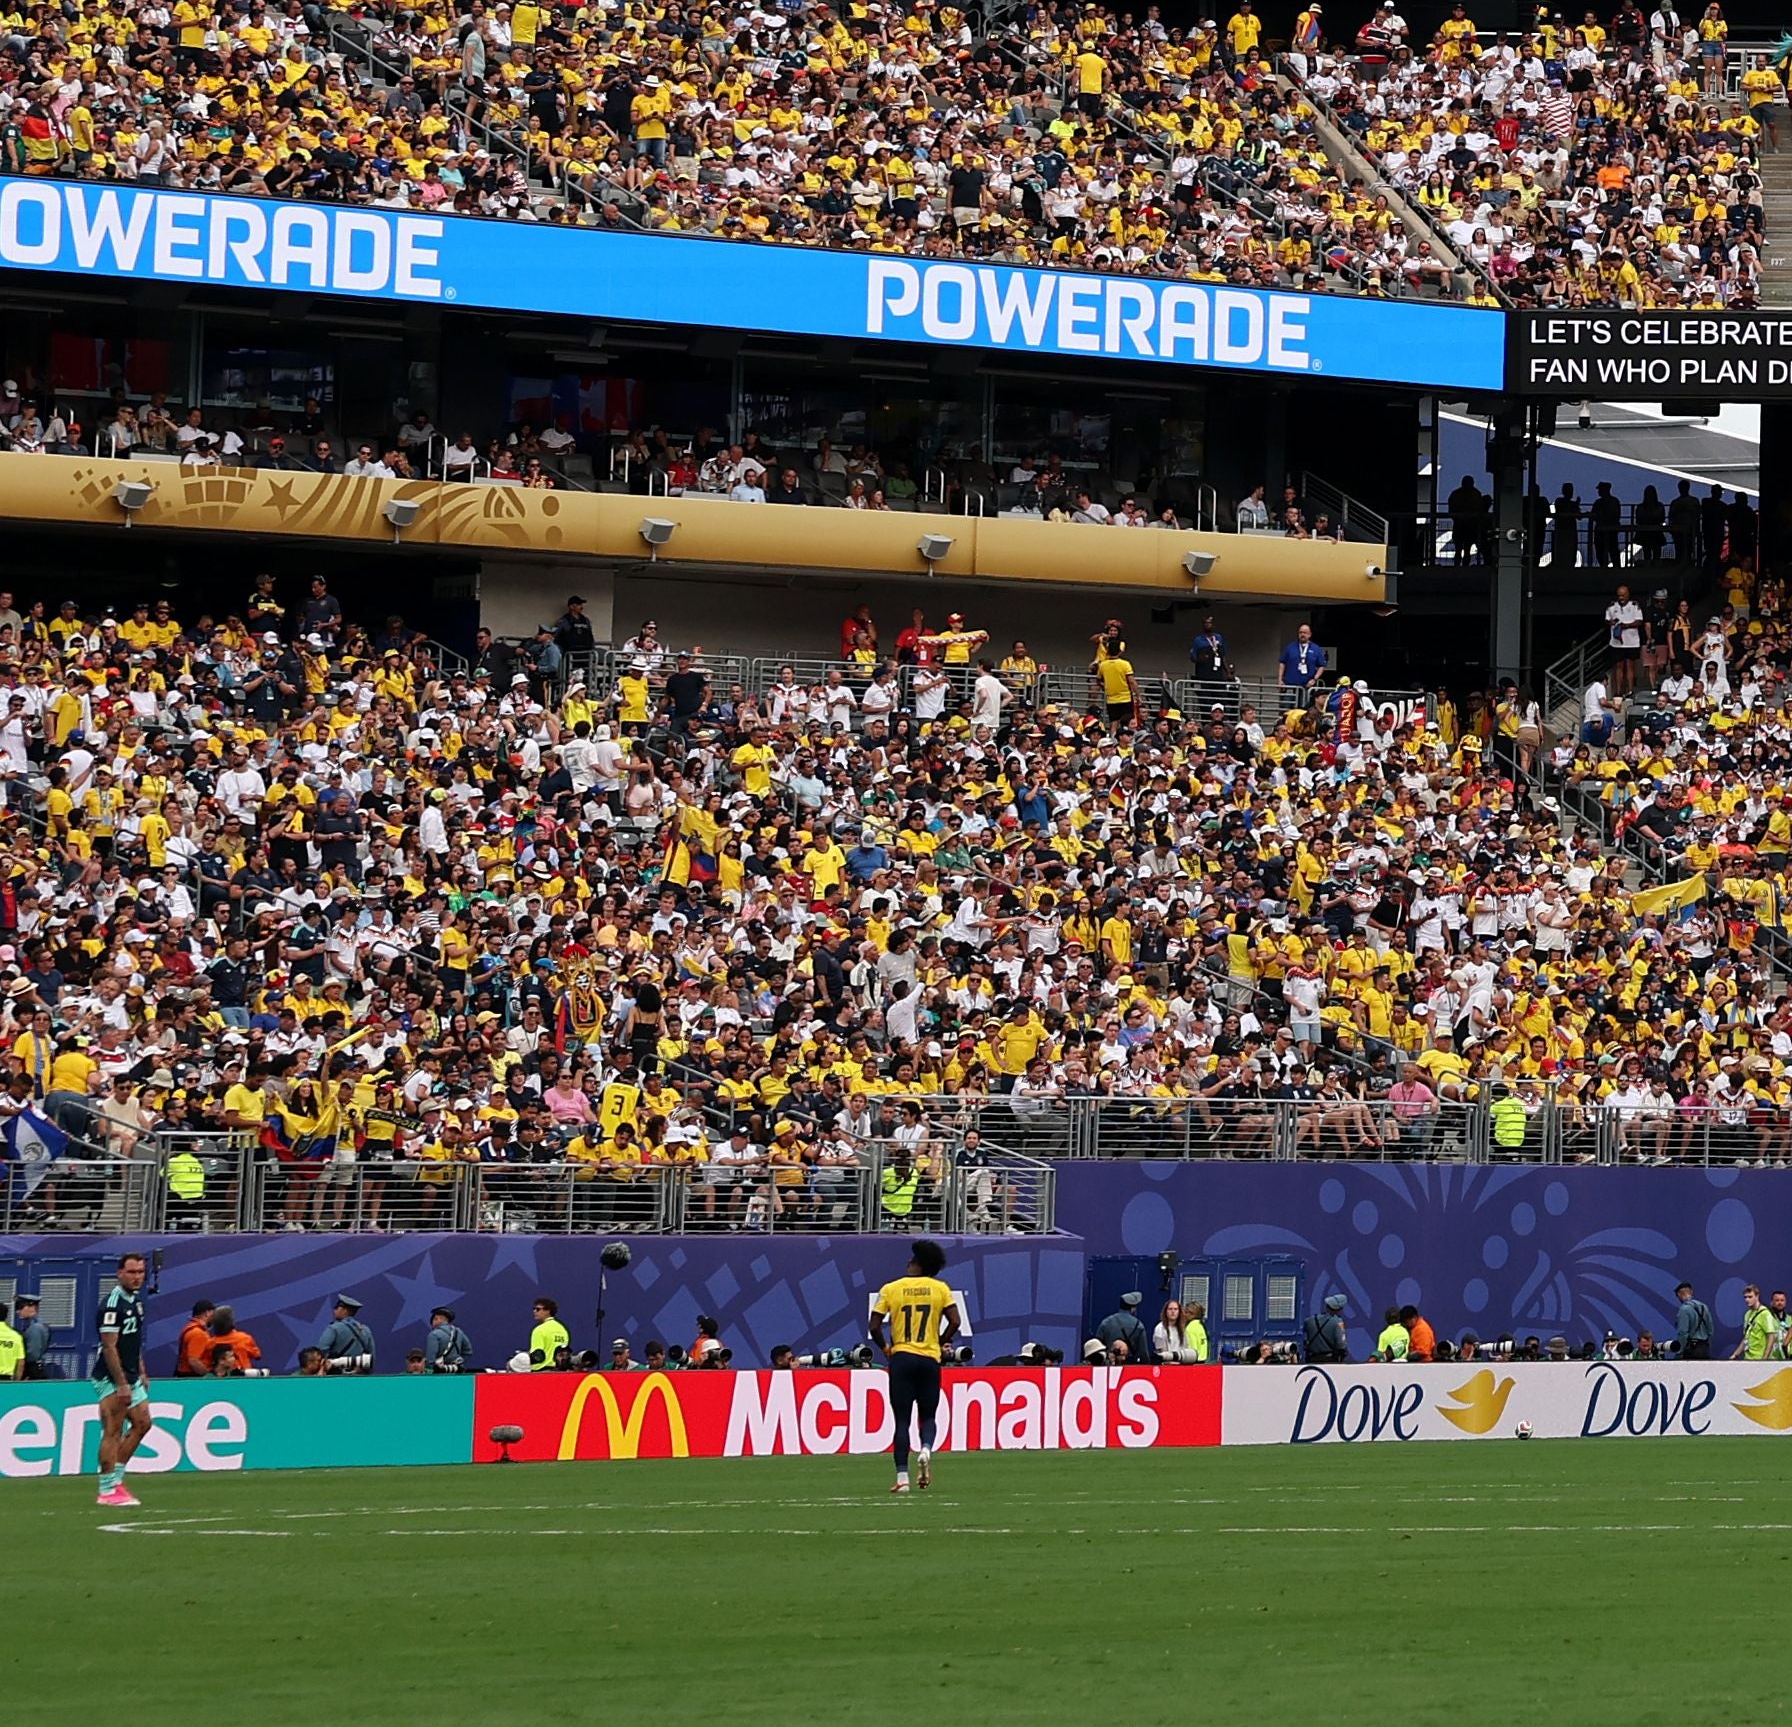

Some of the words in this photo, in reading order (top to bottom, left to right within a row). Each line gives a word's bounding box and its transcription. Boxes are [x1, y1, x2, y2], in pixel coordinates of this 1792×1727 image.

[865, 259, 1310, 368] POWERADE
[1529, 319, 1612, 345] LET'S
[1529, 358, 1588, 384] FAN
[1595, 358, 1672, 385] WHO
[1680, 359, 1758, 385] PLAN
[611, 1095, 625, 1116] 3
[123, 1316, 138, 1334] 22
[901, 1305, 930, 1342] 17
[723, 1365, 1160, 1457] McDonald's
[1292, 1366, 1424, 1444] Dove
[1581, 1363, 1717, 1437] Dove
